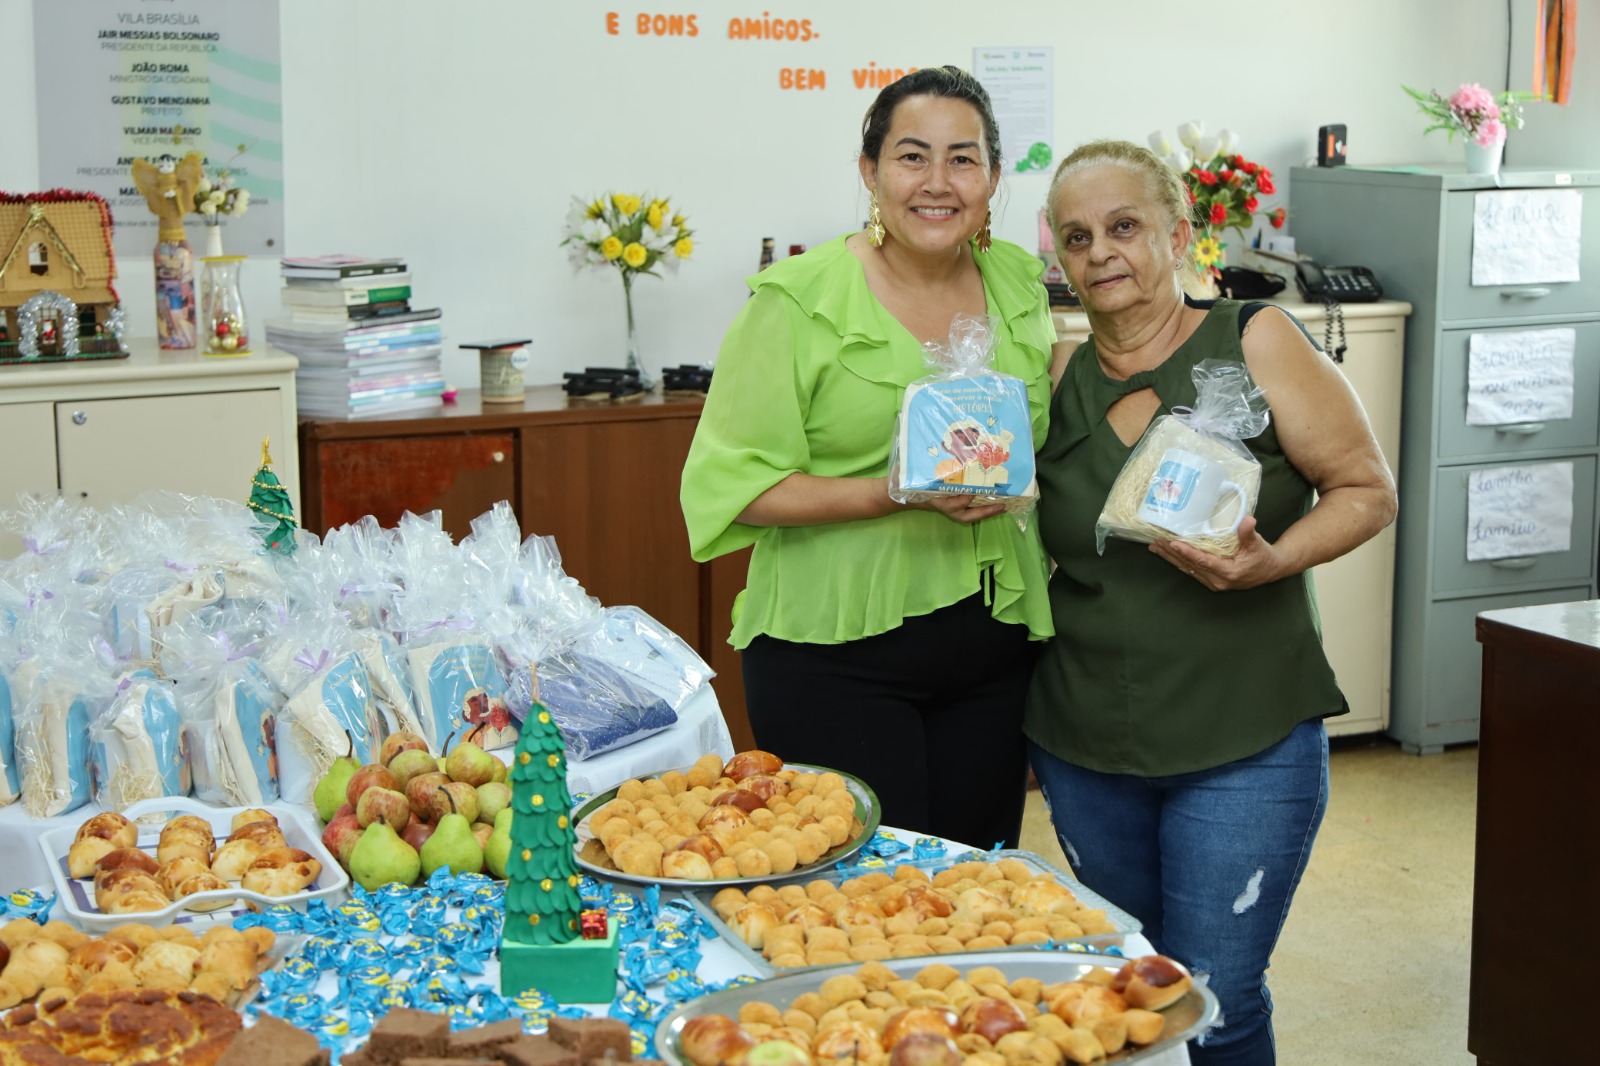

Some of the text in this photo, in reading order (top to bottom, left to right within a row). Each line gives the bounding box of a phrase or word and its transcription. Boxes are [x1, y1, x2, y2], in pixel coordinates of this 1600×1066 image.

[117, 12, 200, 25] VILA BRASÍLIA
[606, 12, 619, 35] E
[637, 13, 699, 37] BONS
[98, 30, 220, 41] JAIR MESSIAS BOLSONARO
[101, 42, 156, 52] PRESIDENTE
[131, 62, 190, 73] JOÃO ROMA
[779, 67, 826, 90] BEM
[111, 96, 211, 105] GUSTAVO MENDANHA
[141, 107, 183, 116] PREFEITO
[123, 127, 158, 136] VILMAR
[76, 168, 128, 176] PRESIDENTE
